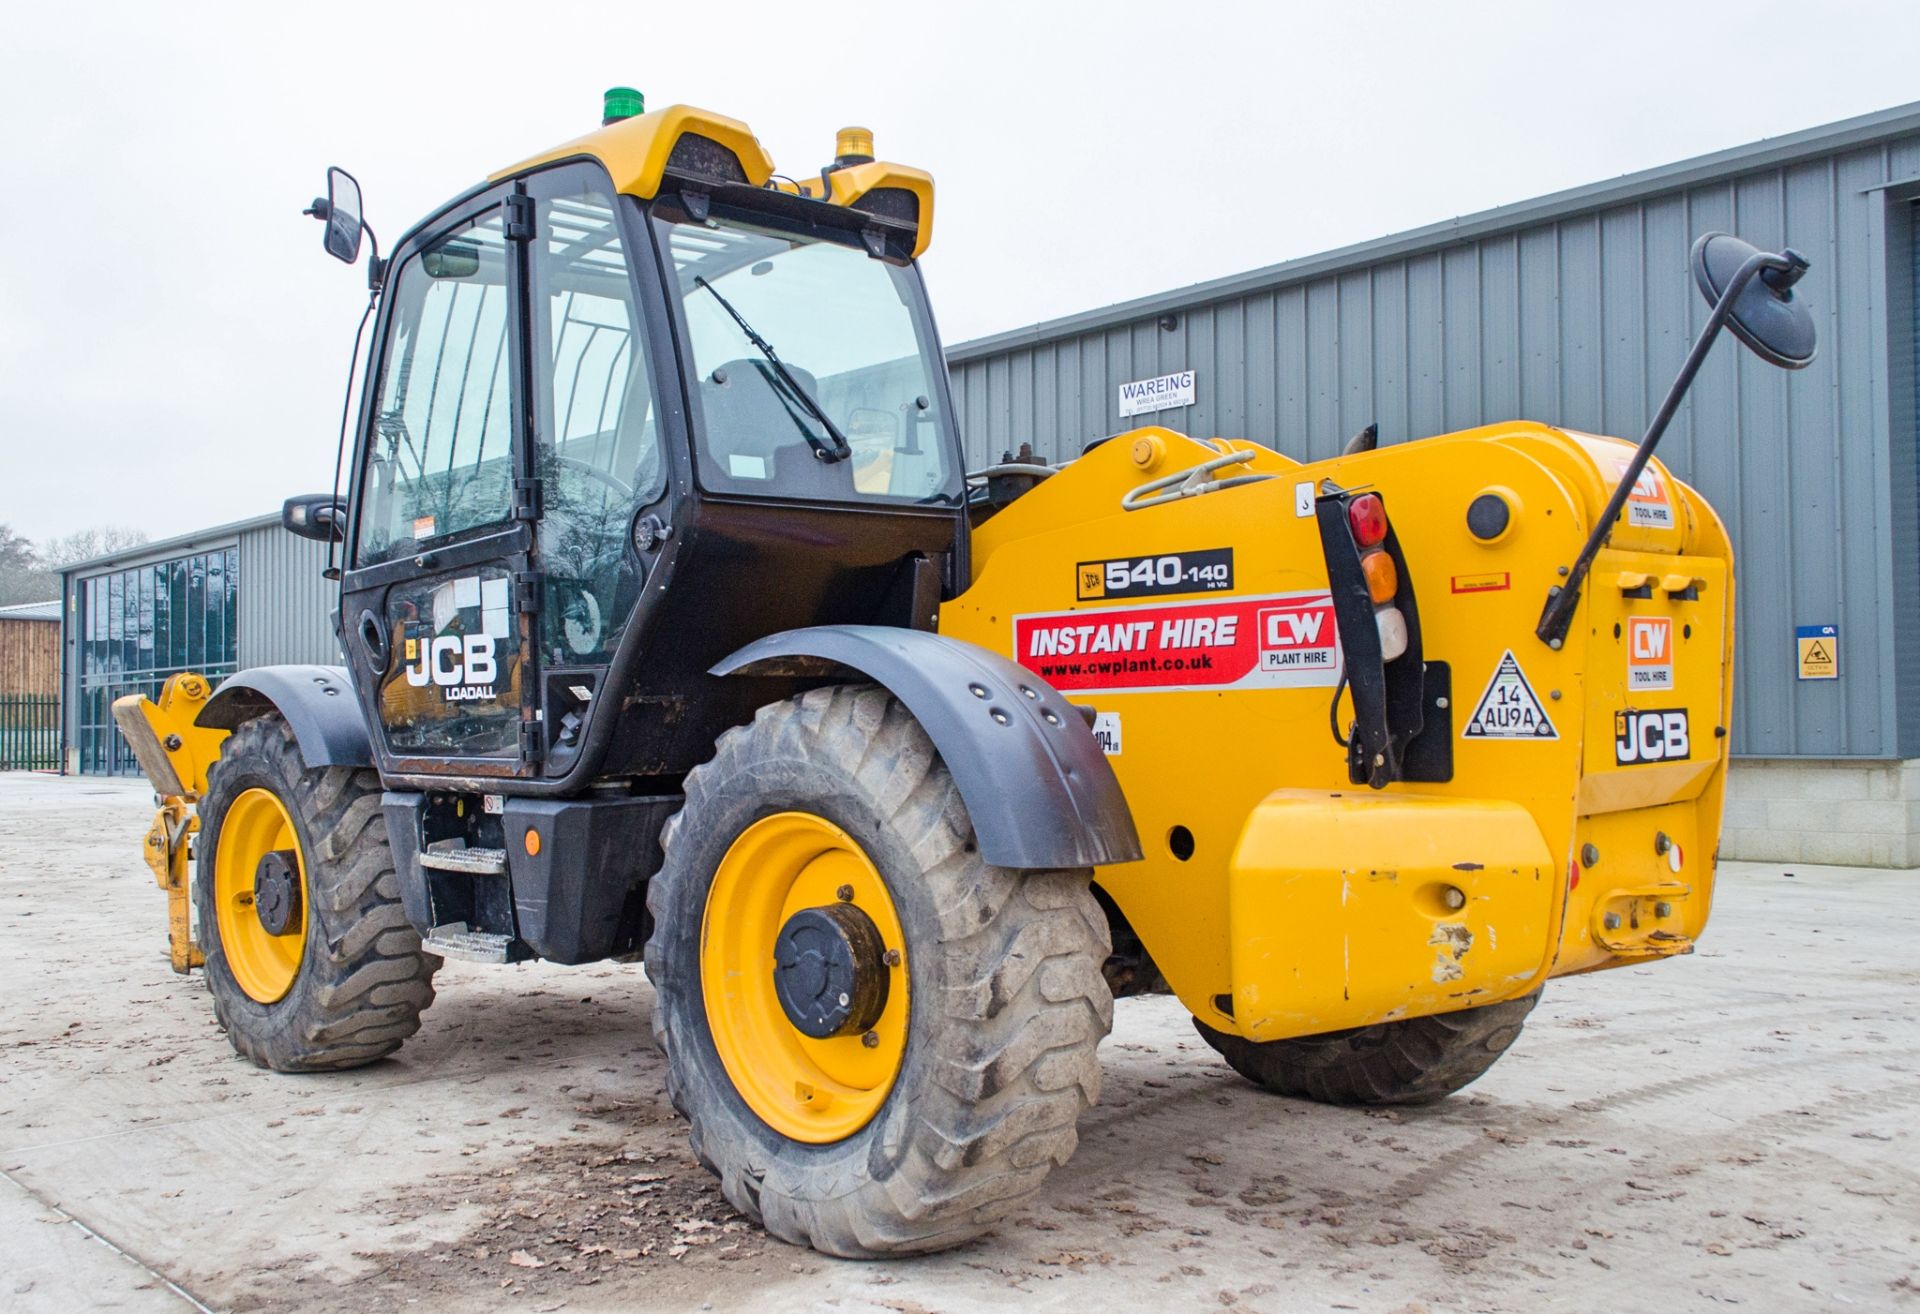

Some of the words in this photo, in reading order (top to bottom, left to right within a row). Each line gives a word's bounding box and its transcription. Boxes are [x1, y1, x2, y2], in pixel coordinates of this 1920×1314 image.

[1123, 373, 1191, 399] WAREING
[1156, 393, 1177, 402] GREEN
[1634, 506, 1652, 518] TOOL
[1653, 509, 1668, 521] HIRE
[1106, 556, 1228, 590] 540-140
[1029, 621, 1154, 657] INSTANT
[1159, 615, 1238, 650] HIRE
[1267, 611, 1325, 646] CW
[1634, 623, 1667, 659] CW
[406, 633, 497, 687] JCB
[1041, 654, 1213, 677] www.cwplant.co.uk
[1270, 653, 1301, 665] PLANT
[1304, 651, 1327, 663] HIRE
[1634, 671, 1651, 682] TOOL
[1652, 670, 1667, 682] HIRE
[446, 686, 496, 700] LOADALL
[1498, 685, 1521, 705] 14
[1485, 707, 1535, 728] AU9A
[1616, 712, 1689, 762] JCB
